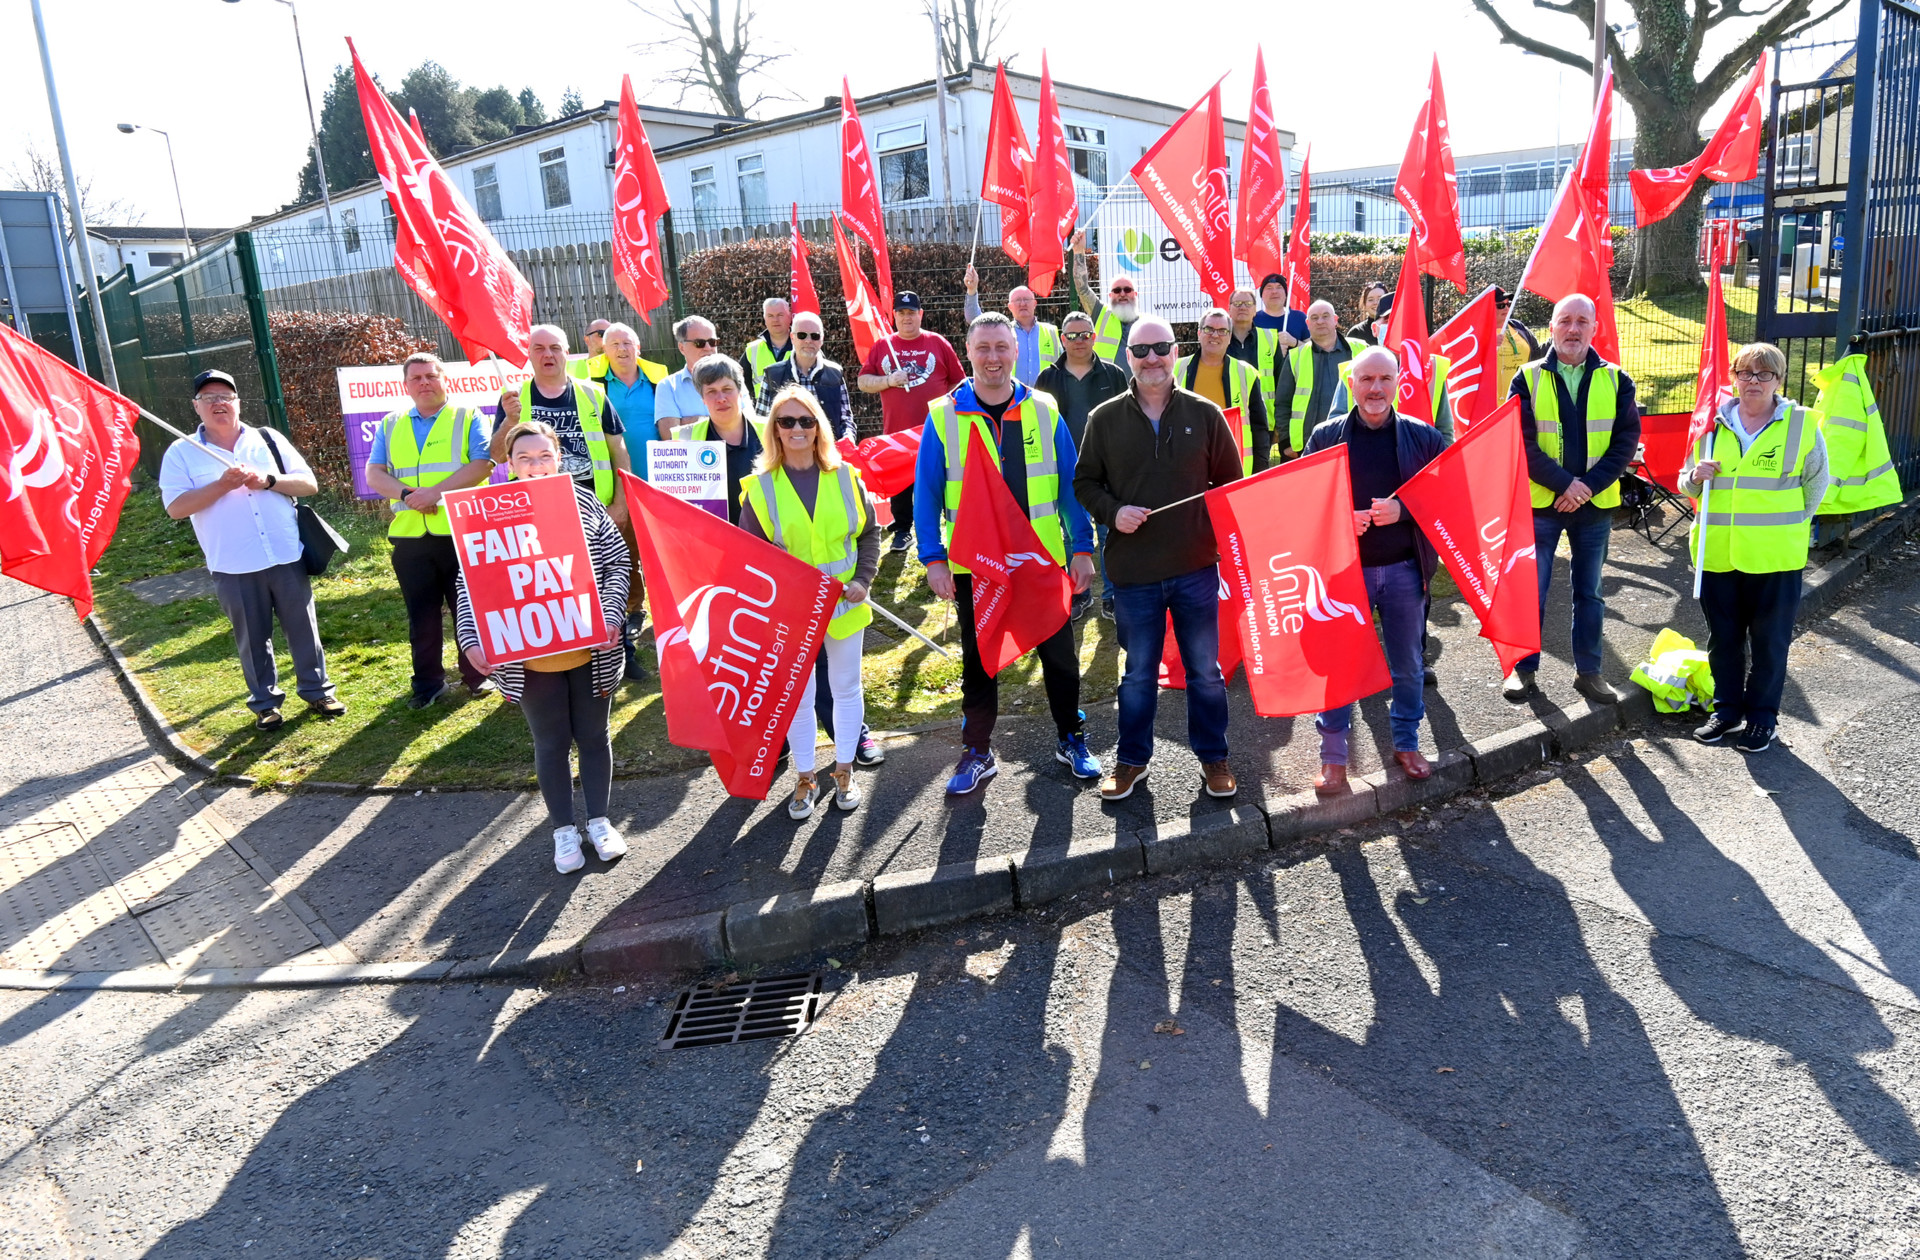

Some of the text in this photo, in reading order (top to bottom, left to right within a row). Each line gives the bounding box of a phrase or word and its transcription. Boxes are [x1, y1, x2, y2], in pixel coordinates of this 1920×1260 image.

[1160, 237, 1190, 262] e
[1153, 299, 1214, 310] www.eani.or
[348, 380, 411, 399] EDUCATI
[444, 375, 488, 394] RKERS
[531, 409, 577, 417] OLKSWAGE
[653, 448, 688, 457] EDUCATION
[654, 460, 688, 469] AUTHORITY
[654, 472, 721, 482] WORKERS STRIKE FOR
[656, 485, 702, 494] PROVED PAY!
[453, 490, 532, 522] nipsa
[462, 523, 544, 567] FAIR
[507, 554, 574, 600] PAY
[1228, 532, 1264, 675] www.unitetheunion.org
[1269, 551, 1304, 634] unite
[1259, 578, 1281, 637] theUNION
[485, 593, 593, 656] NOW
